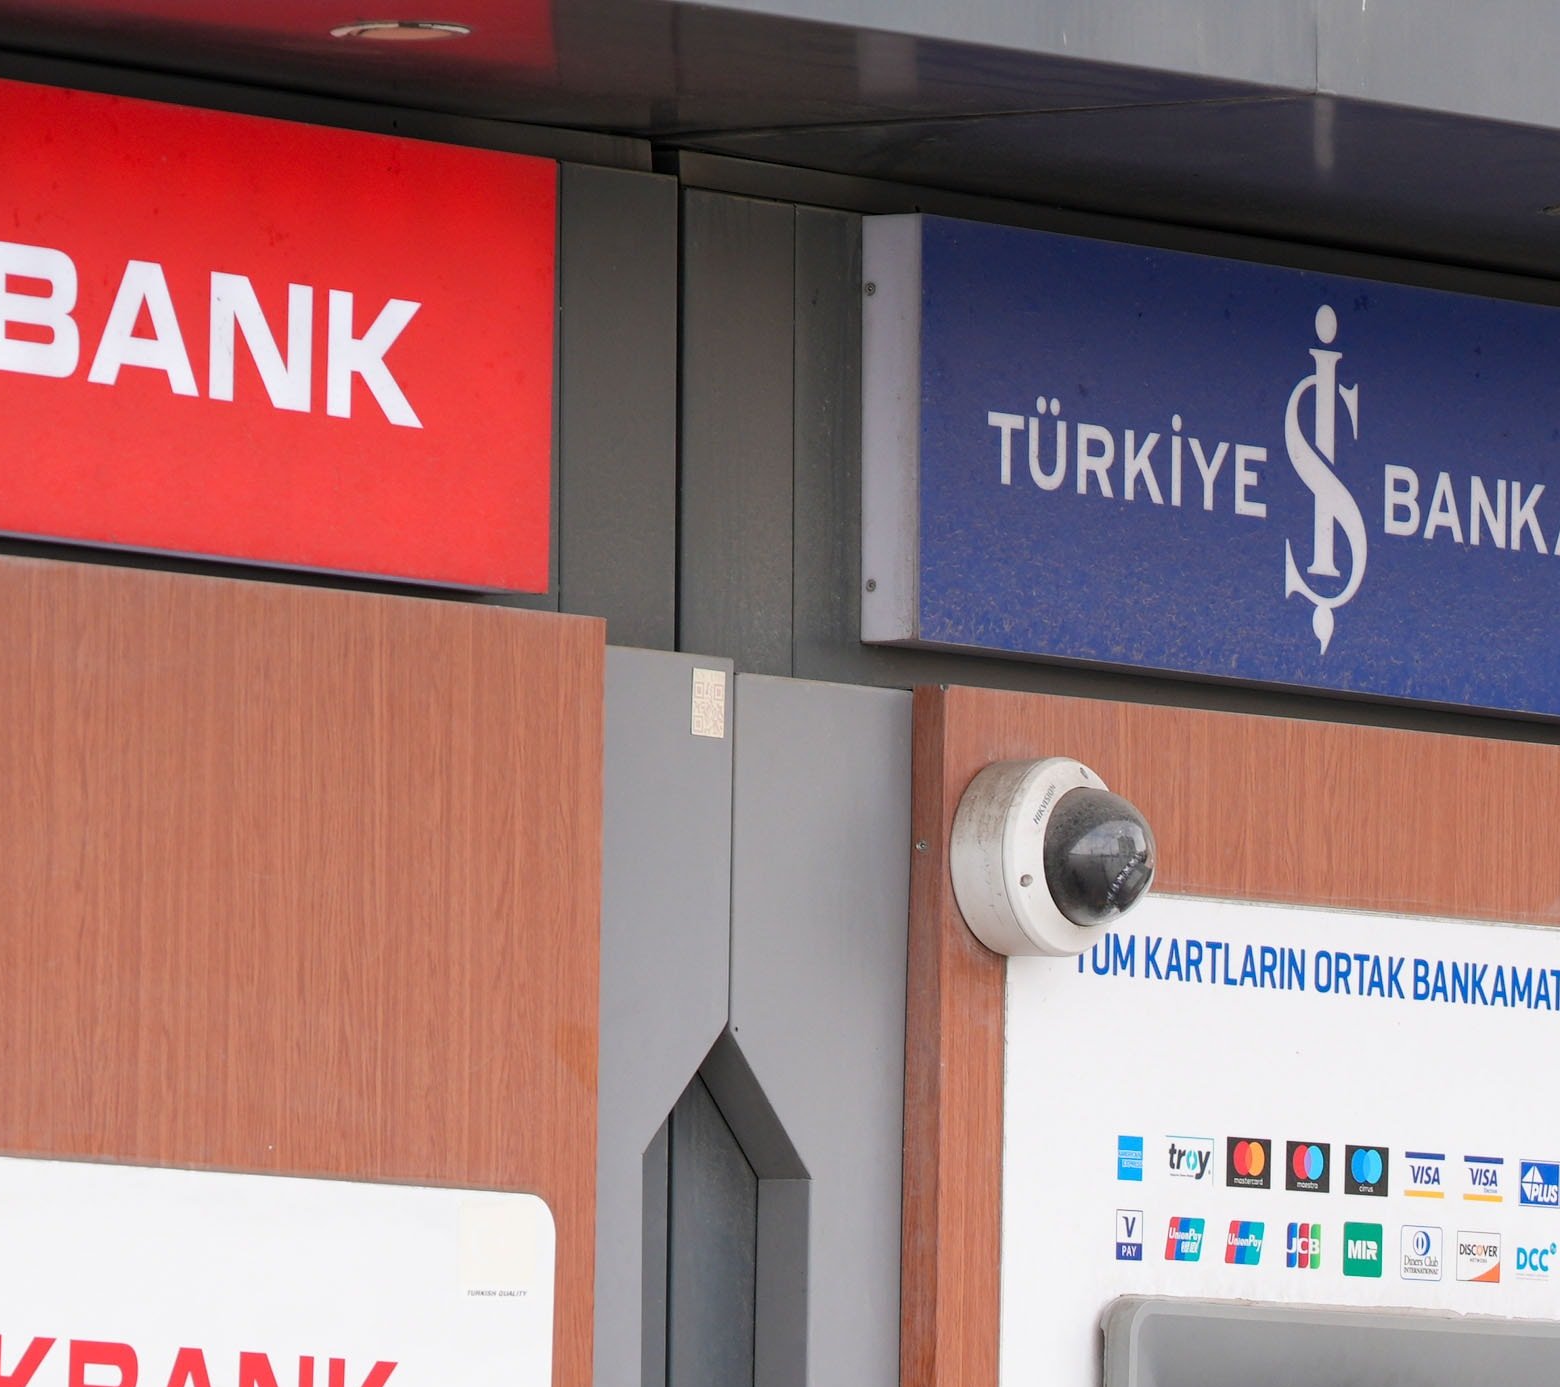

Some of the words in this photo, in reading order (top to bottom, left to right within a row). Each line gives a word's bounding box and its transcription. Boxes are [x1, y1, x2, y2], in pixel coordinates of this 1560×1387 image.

[988, 396, 1267, 518] TÜRKİYE
[1144, 936, 1305, 991] KARTLARIN
[1313, 949, 1405, 999] ORTAK
[1169, 1143, 1210, 1180] troy
[1233, 1177, 1264, 1186] mastercard
[1409, 1165, 1440, 1185] VISA
[1468, 1168, 1498, 1187] VISA
[1296, 1181, 1319, 1190] maestro
[1532, 1183, 1559, 1203] PLUS
[1122, 1216, 1136, 1238] V
[1168, 1227, 1203, 1241] UnionPay
[1121, 1245, 1137, 1257] PAY
[1227, 1233, 1262, 1252] UnionPay
[1286, 1238, 1320, 1255] JCB
[1348, 1239, 1377, 1261] MIR
[1459, 1243, 1498, 1258] DISCOVER
[1404, 1256, 1423, 1266] Diners
[1424, 1255, 1439, 1267] Club
[1516, 1247, 1549, 1272] DCC
